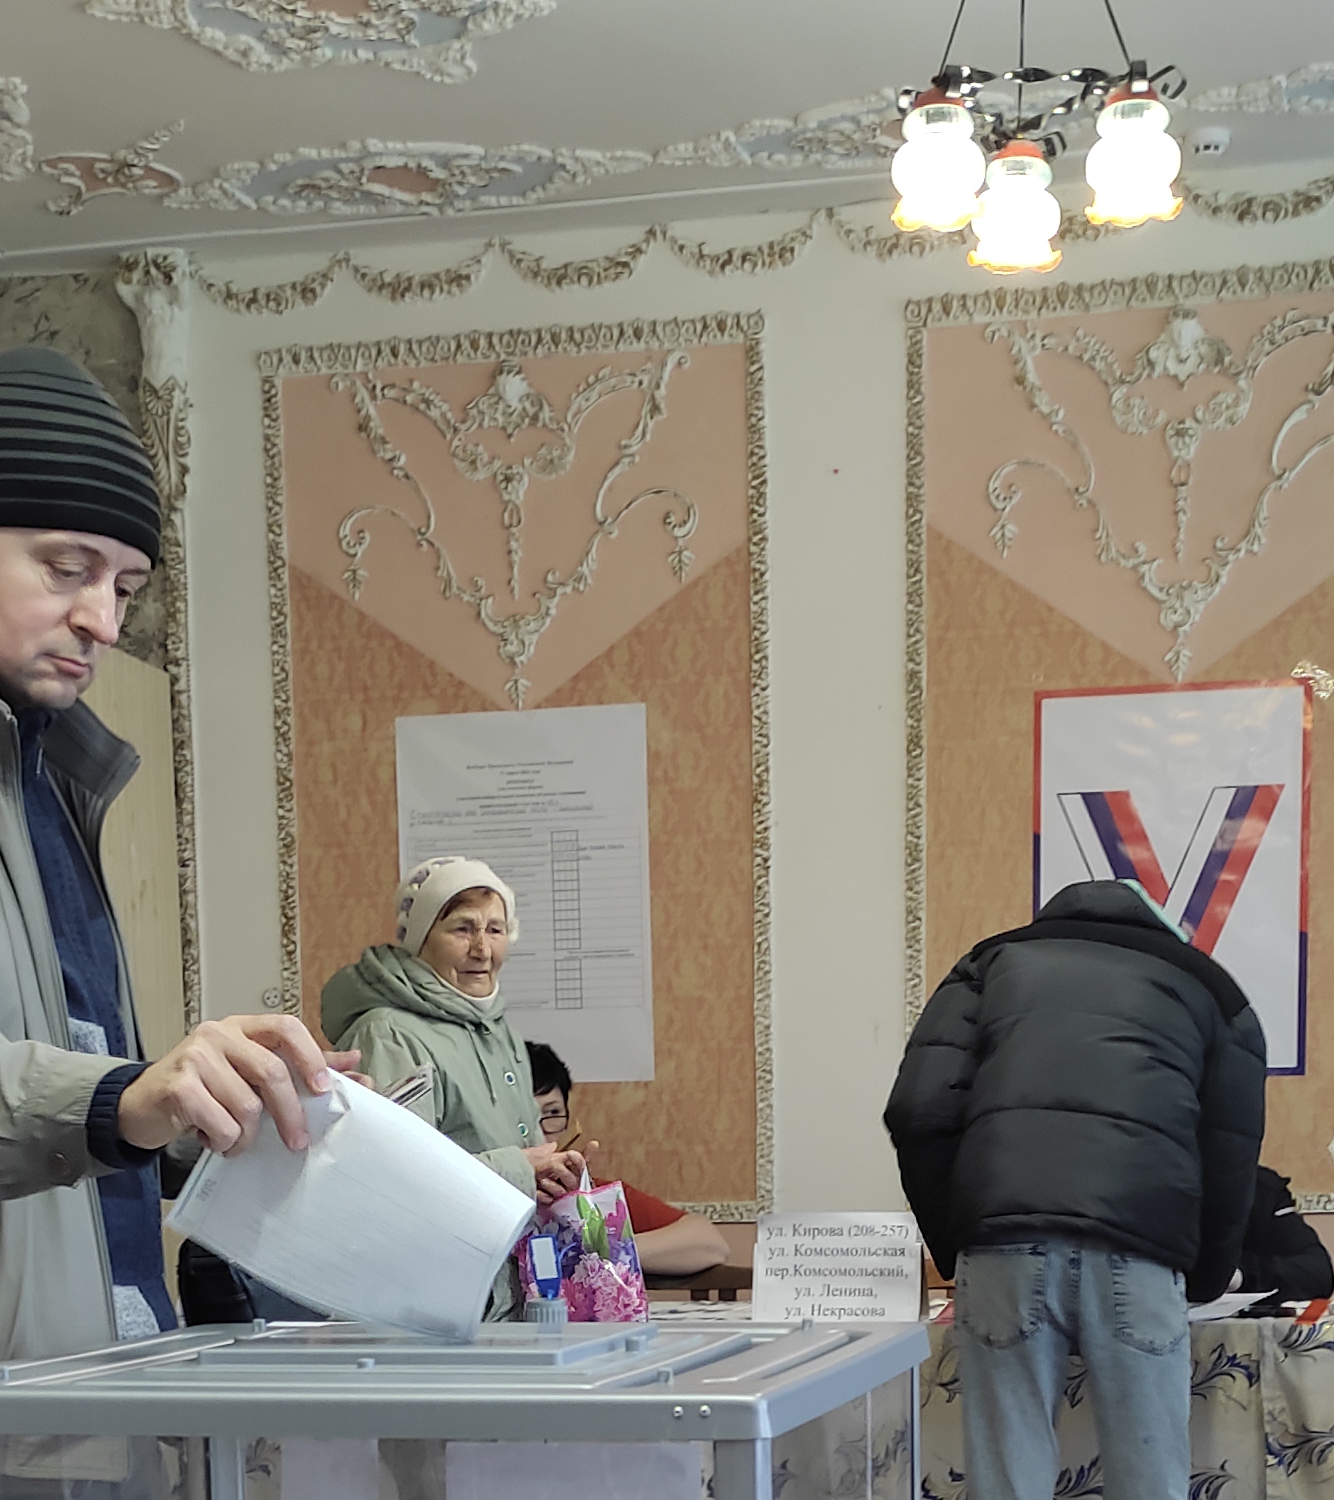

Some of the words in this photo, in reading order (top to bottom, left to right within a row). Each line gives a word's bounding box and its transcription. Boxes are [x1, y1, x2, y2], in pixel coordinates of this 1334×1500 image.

[766, 1225, 787, 1239] ул.
[792, 1223, 844, 1240] Кирова
[768, 1245, 789, 1260] ул.
[793, 1243, 906, 1258] Комсомольская
[794, 1286, 815, 1300] ул.
[819, 1284, 878, 1299] Ленина,
[785, 1306, 805, 1320] ул.
[810, 1303, 886, 1320] Некрасова
